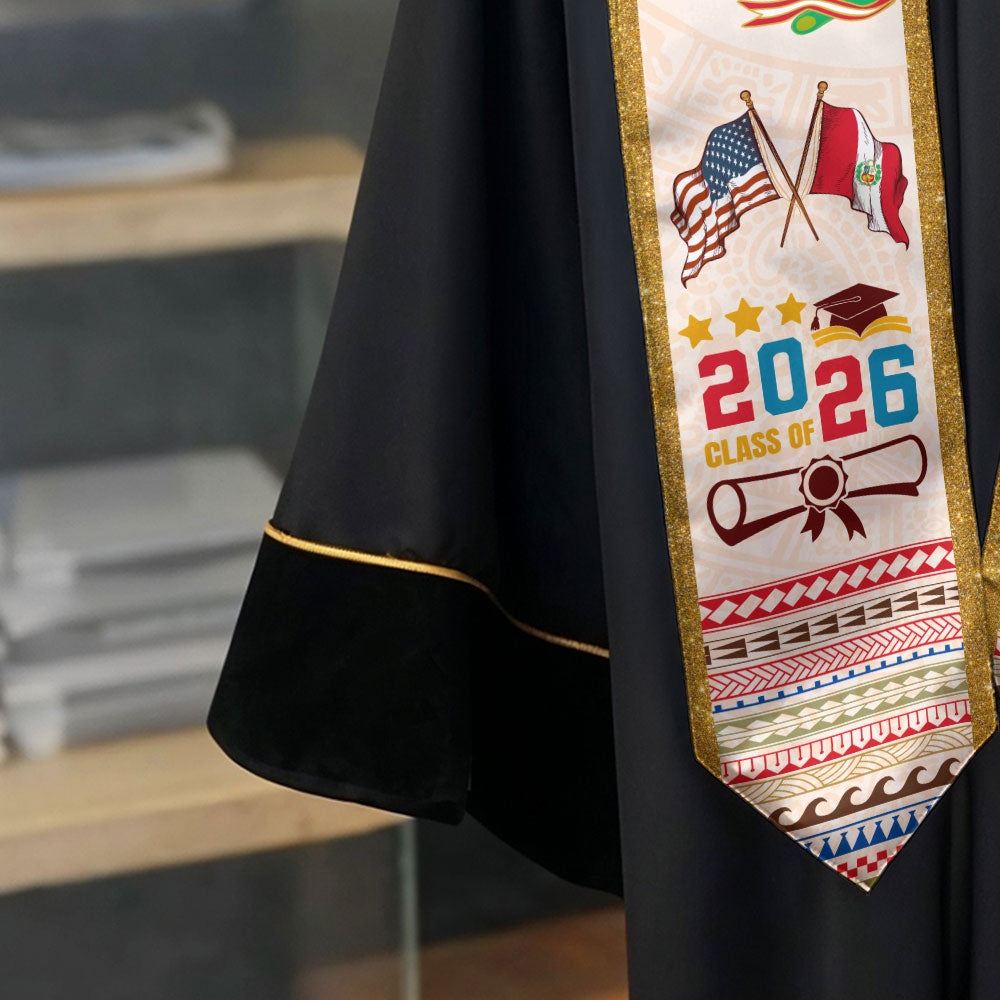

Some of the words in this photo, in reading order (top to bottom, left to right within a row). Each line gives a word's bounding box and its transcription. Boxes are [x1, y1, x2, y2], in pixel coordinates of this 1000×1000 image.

[697, 337, 919, 442] 2026
[704, 428, 782, 469] CLASS
[788, 419, 815, 450] OF
